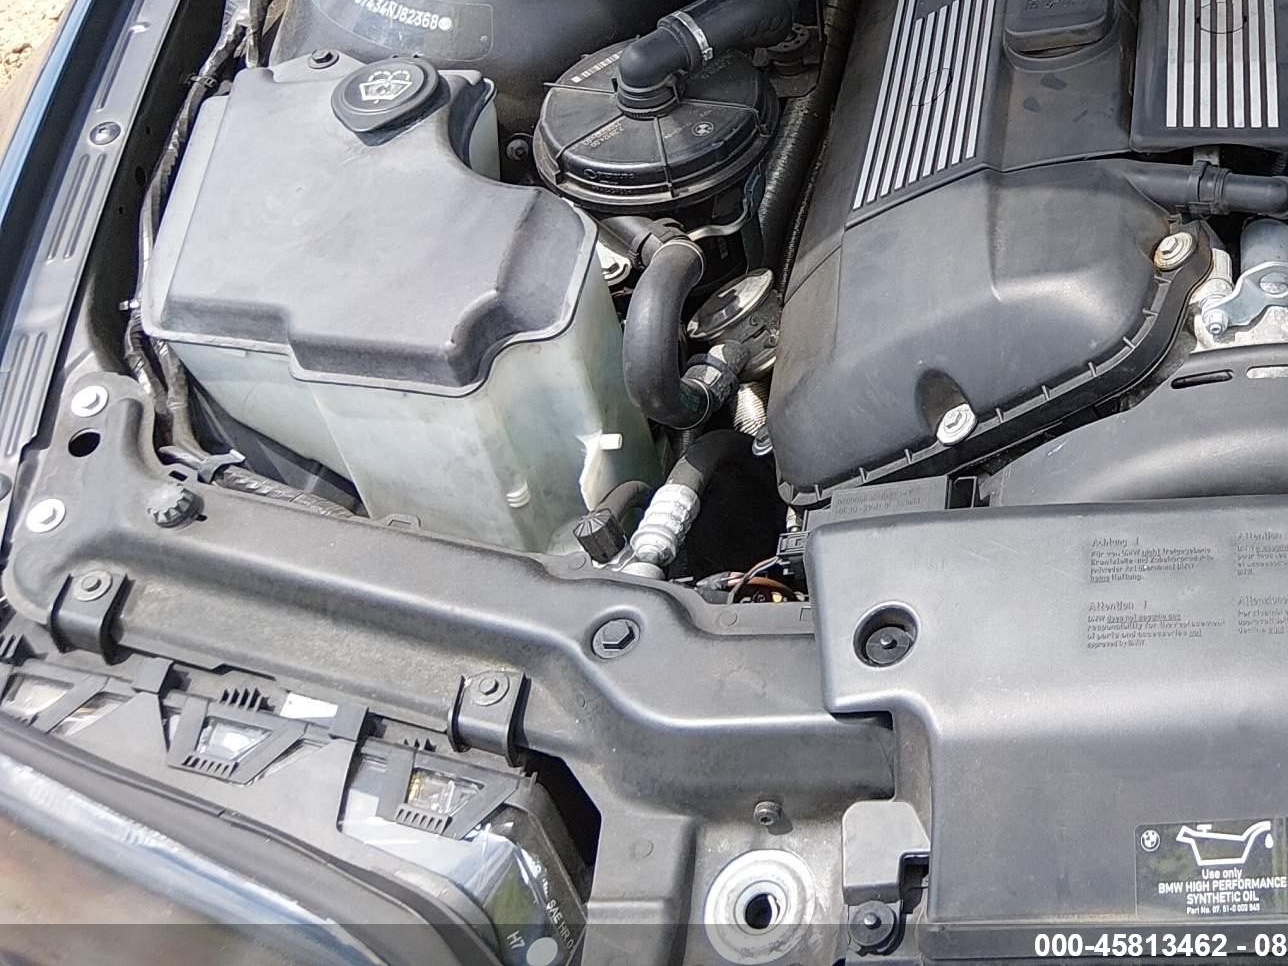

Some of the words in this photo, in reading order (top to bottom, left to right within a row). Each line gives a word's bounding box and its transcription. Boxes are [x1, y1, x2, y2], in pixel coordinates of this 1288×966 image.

[1202, 869, 1220, 879] Use
[1223, 867, 1242, 880] only
[1158, 882, 1183, 894] BMW
[1186, 880, 1209, 892] HIGH
[1212, 877, 1287, 891] PERFORMANCE
[1187, 891, 1241, 904] SYNTHETIC
[1243, 890, 1259, 902] OIL
[1187, 906, 1199, 914] Part
[1201, 905, 1211, 913] No.
[547, 900, 563, 924] SAE
[558, 922, 570, 941] HR
[507, 930, 525, 950] H7
